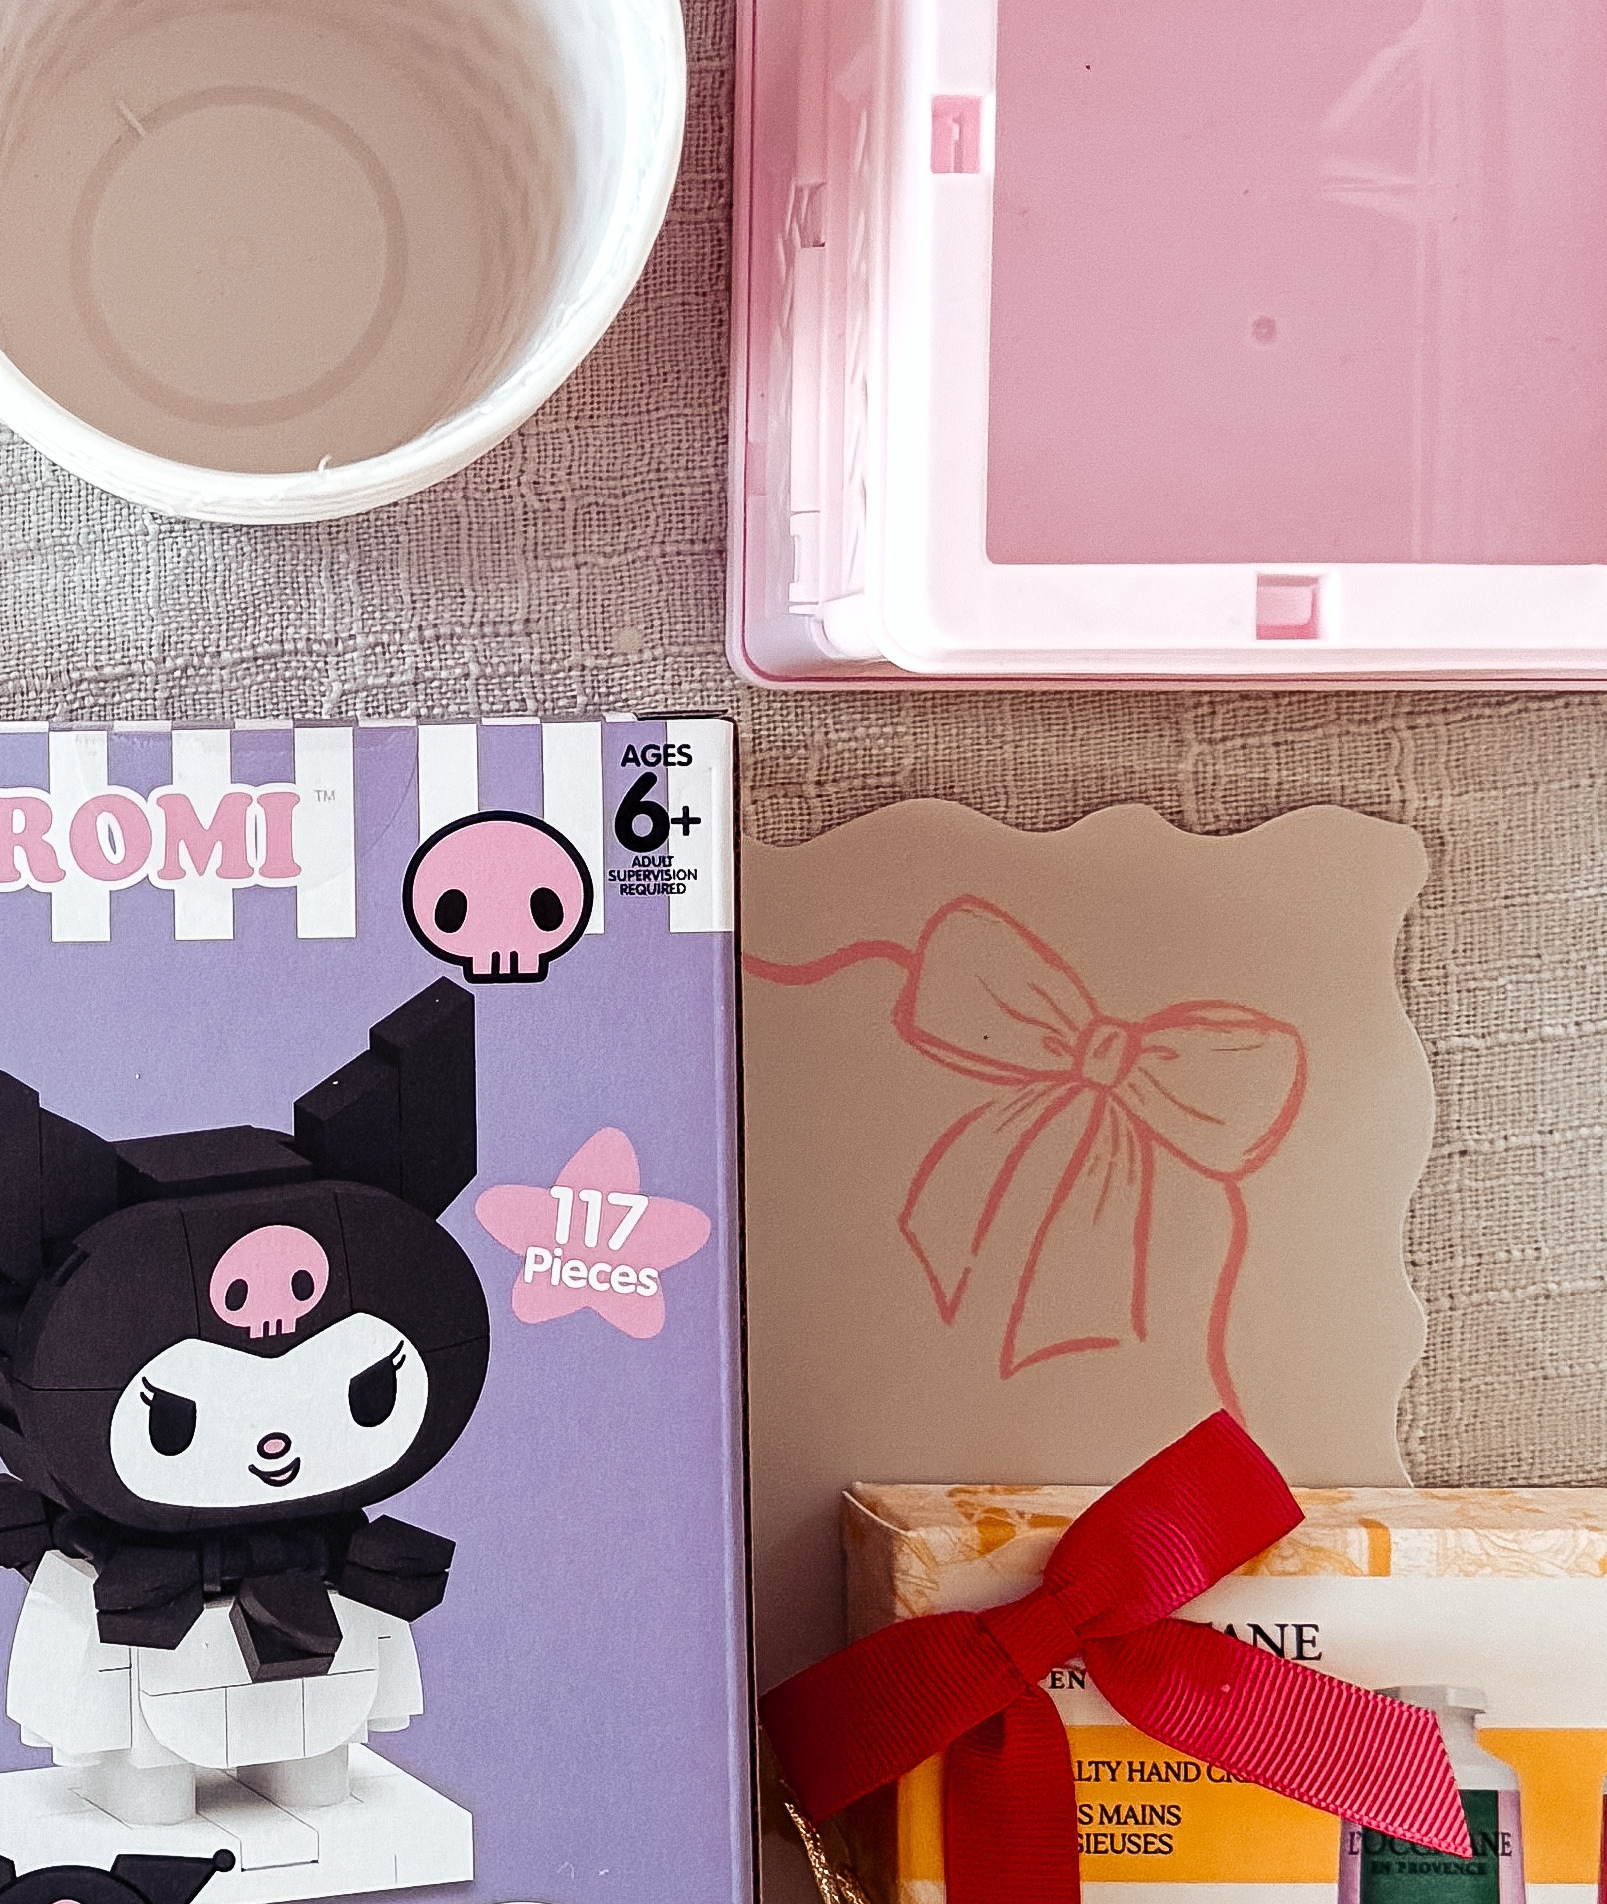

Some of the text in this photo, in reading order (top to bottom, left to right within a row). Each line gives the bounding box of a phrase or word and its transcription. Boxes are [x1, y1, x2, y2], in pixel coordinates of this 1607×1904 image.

[620, 744, 693, 768] AGES
[614, 771, 702, 854] 6+
[631, 855, 674, 868] ADULT
[608, 869, 698, 882] SUPERVISION
[619, 883, 687, 896] REQUIRED
[548, 1184, 651, 1251] 117
[524, 1246, 660, 1298] Pieces
[1127, 1760, 1202, 1782] HAND
[1099, 1804, 1182, 1826] MAINS
[1397, 1861, 1488, 1875] PROVENCE
